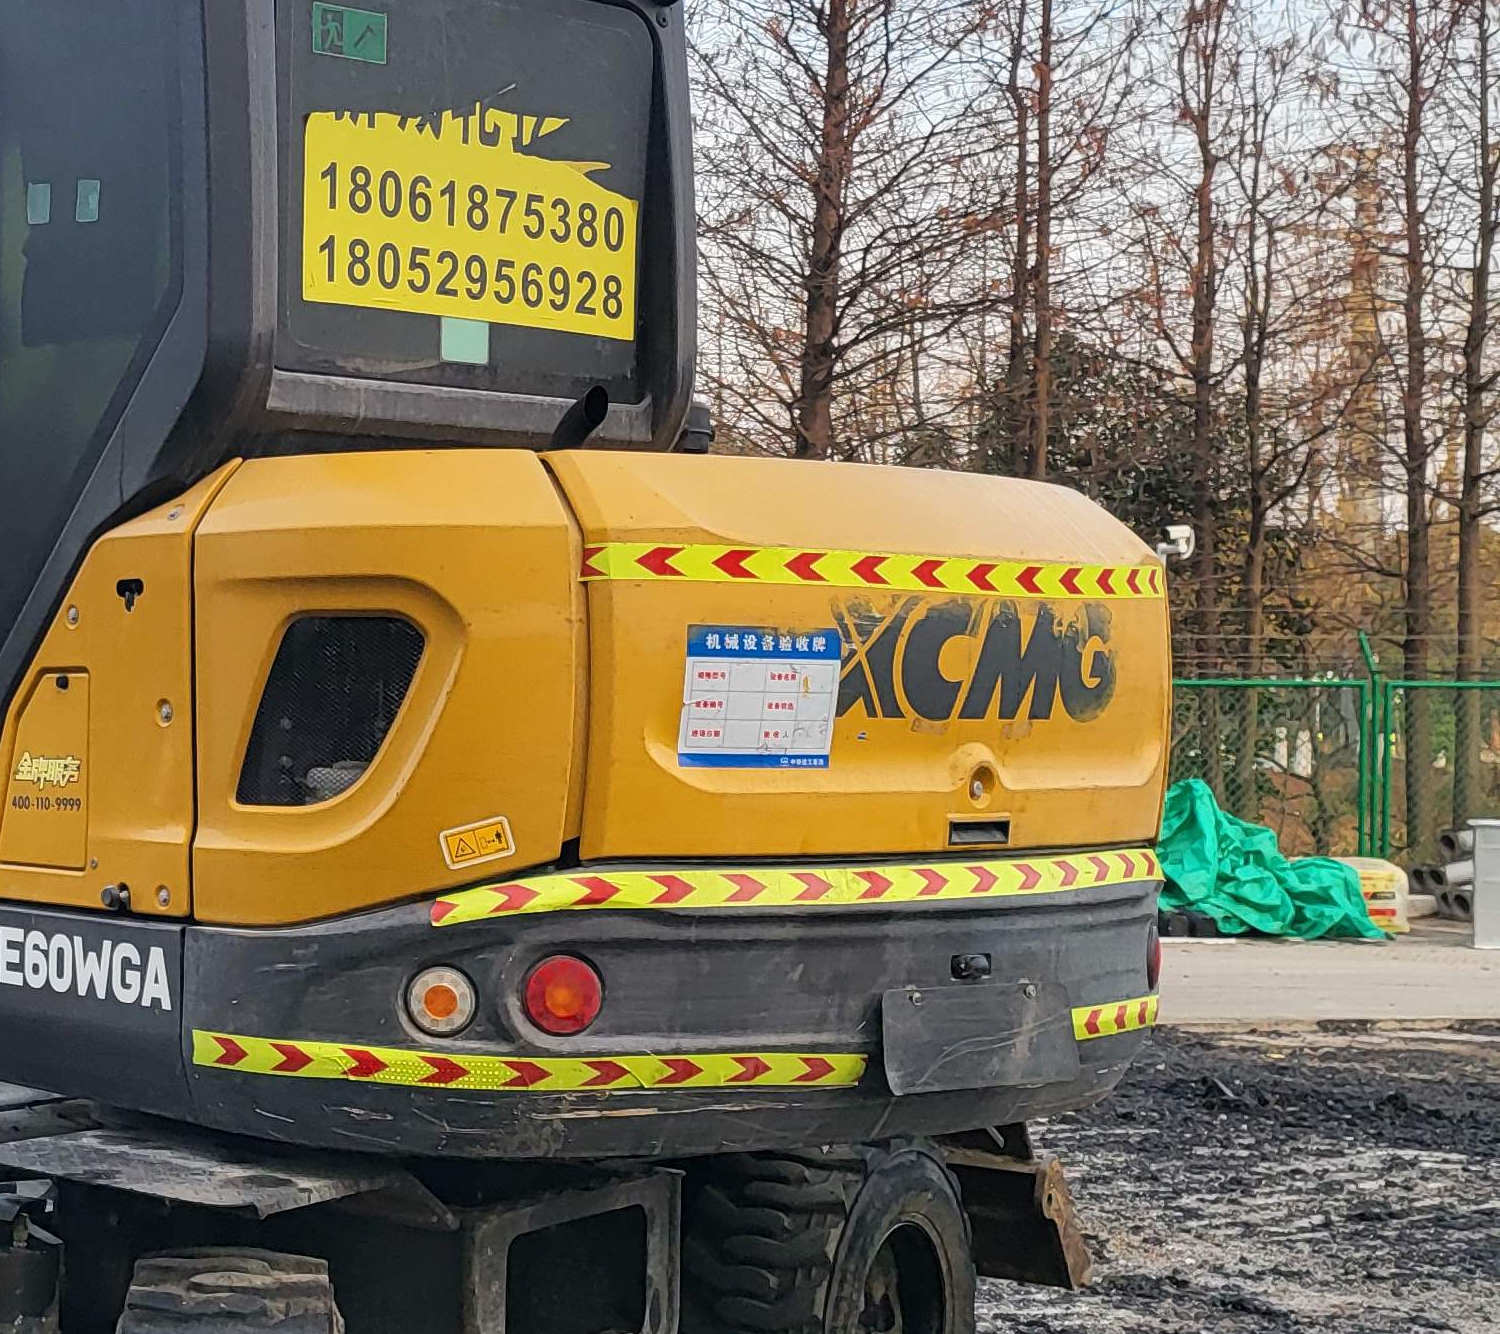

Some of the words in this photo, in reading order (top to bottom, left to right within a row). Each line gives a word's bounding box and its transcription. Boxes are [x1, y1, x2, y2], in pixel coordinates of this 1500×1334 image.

[320, 162, 625, 252] 18061875380
[318, 234, 623, 320] 18052956928
[705, 633, 827, 652] 机械设备验收牌
[832, 596, 1117, 723] XCMG
